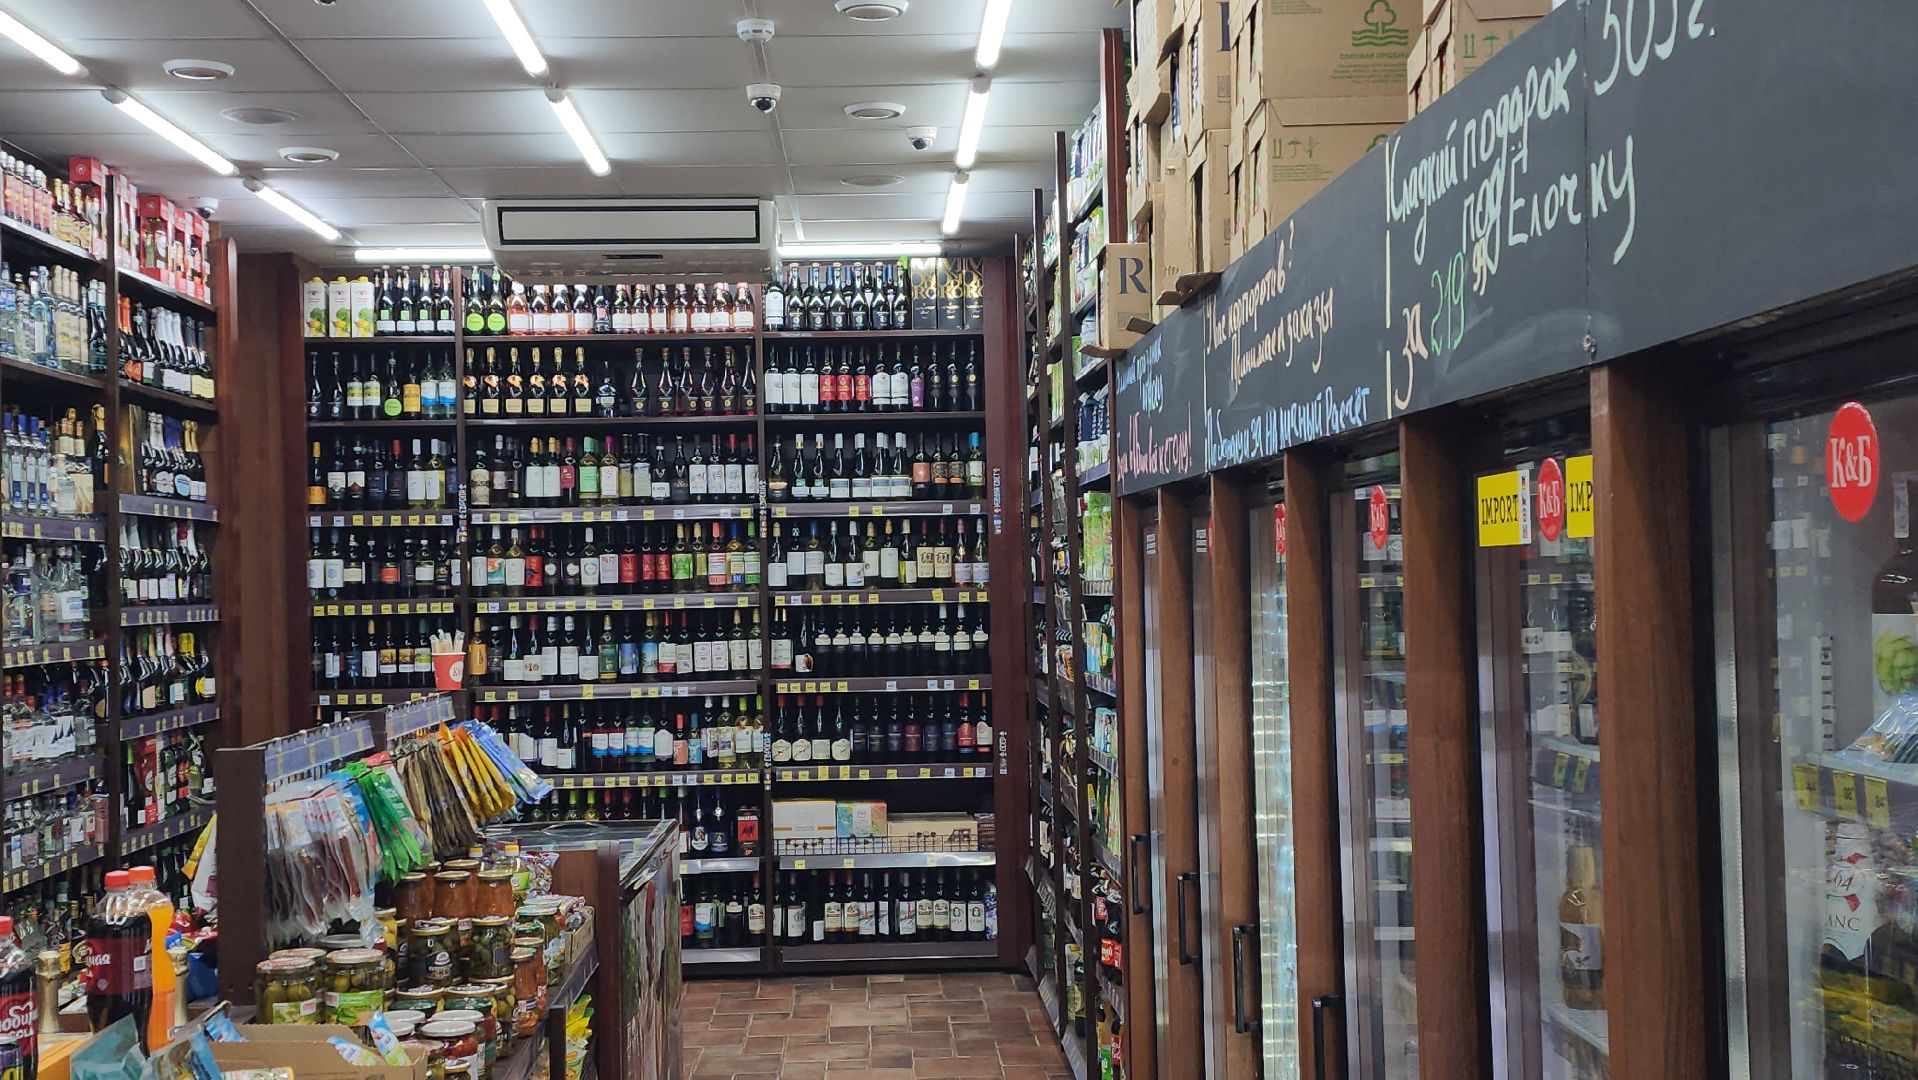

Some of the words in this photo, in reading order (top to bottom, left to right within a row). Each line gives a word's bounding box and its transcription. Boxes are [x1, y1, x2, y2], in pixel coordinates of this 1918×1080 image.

[1390, 118, 1459, 265] Сладкий
[1463, 47, 1578, 181] подарок
[1463, 157, 1504, 275] под
[1508, 134, 1636, 265] Ёлочку
[1117, 257, 1149, 294] R
[1430, 252, 1465, 356] 219
[1286, 287, 1334, 374] заказы
[1830, 435, 1871, 488] К&Б
[1481, 494, 1519, 525] IMPORT
